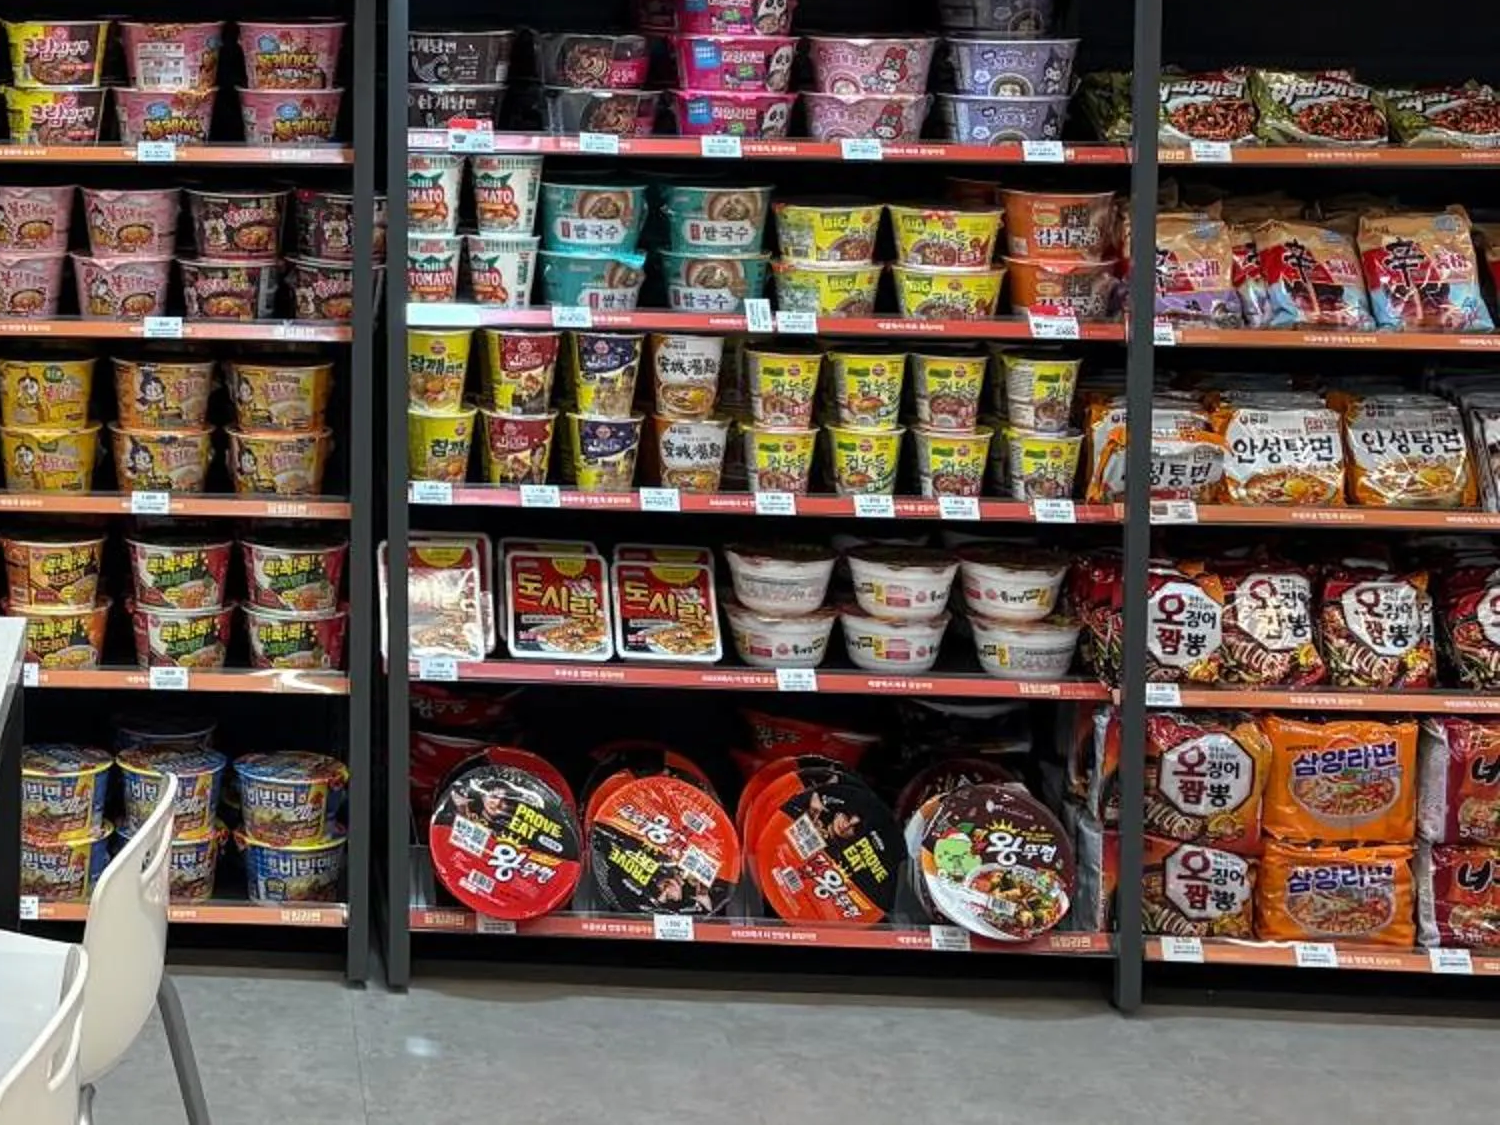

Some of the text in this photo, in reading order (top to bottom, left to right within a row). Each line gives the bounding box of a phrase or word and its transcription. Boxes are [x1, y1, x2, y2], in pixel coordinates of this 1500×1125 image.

[1233, 435, 1334, 464] 안성탕면
[1361, 428, 1463, 456] 안성탕면
[1148, 461, 1212, 485] 성탕면
[518, 573, 598, 620] 도시락
[625, 580, 707, 626] 도시락
[1173, 746, 1241, 779] 오징어
[1294, 741, 1396, 776] 삼양라면
[1178, 779, 1231, 806] 짬뽕
[508, 818, 538, 841] EAT
[515, 803, 563, 837] PROVE
[842, 843, 869, 875] EAT
[855, 835, 889, 883] PROVE
[1178, 850, 1245, 887] 오징어
[1288, 866, 1393, 894] 삼양라면
[1184, 884, 1236, 912] 짬뽕
